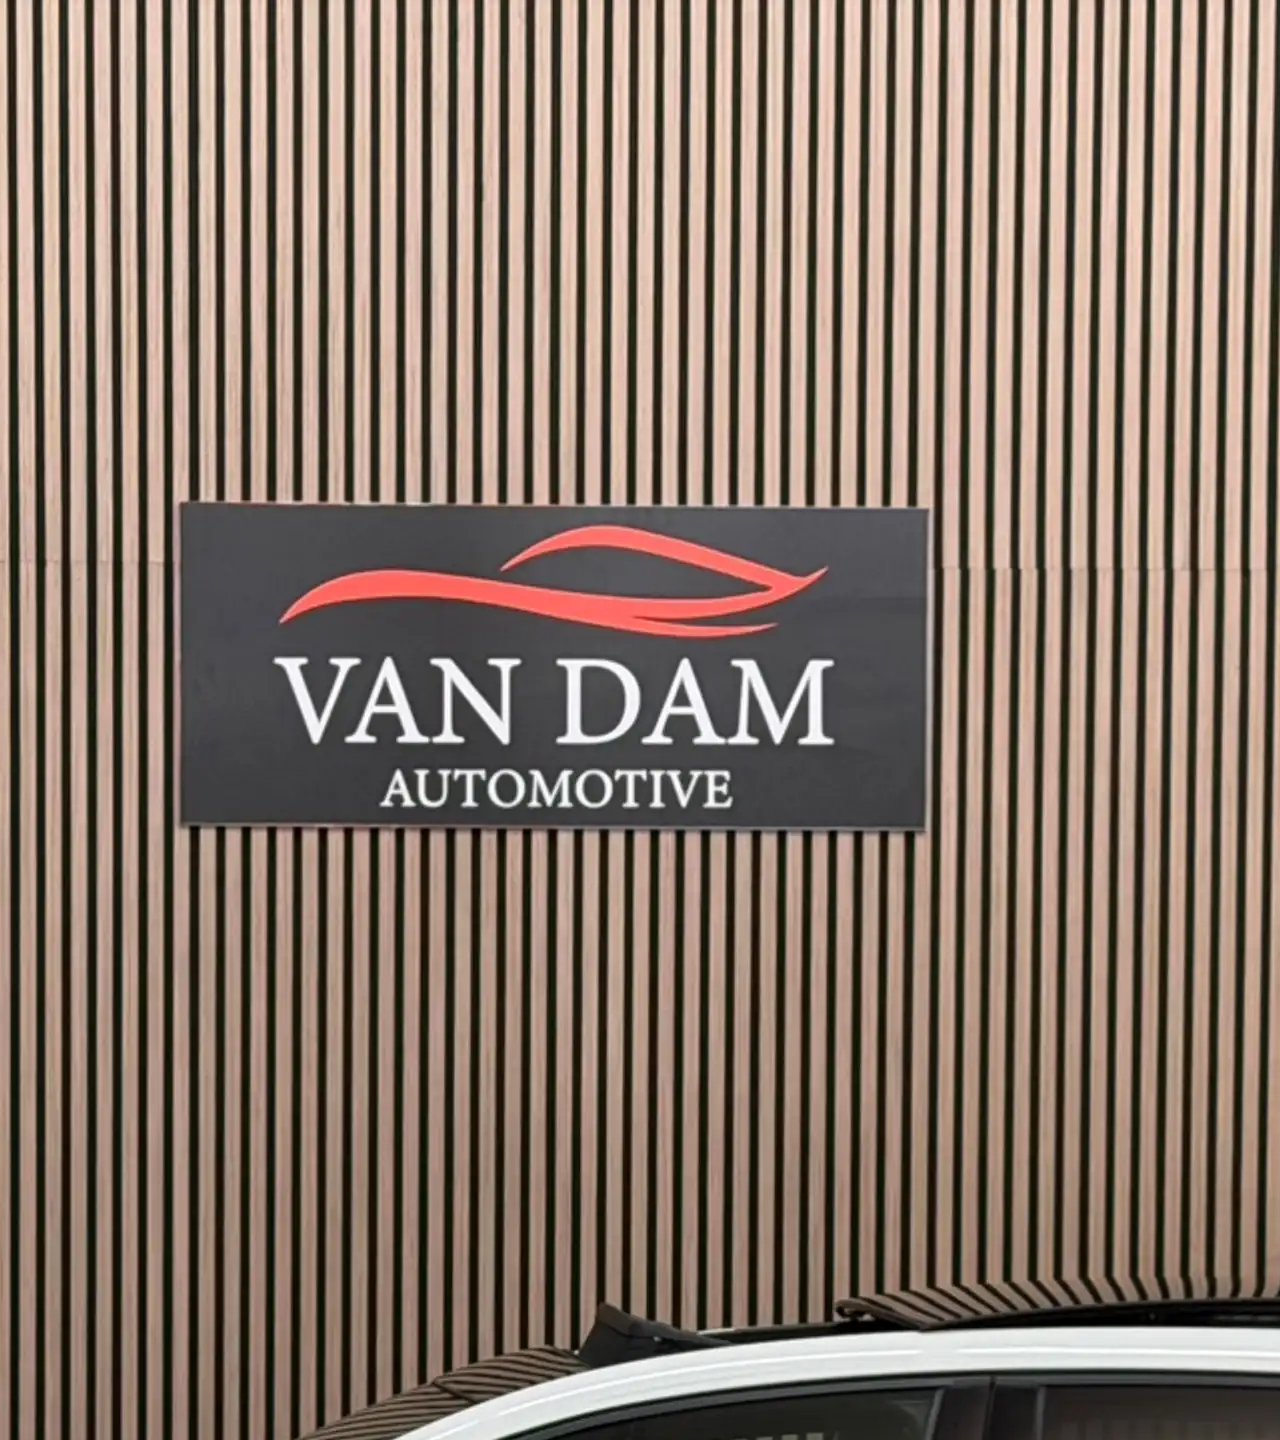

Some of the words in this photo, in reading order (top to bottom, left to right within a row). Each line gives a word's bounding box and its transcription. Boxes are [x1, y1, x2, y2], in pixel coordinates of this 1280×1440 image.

[274, 656, 522, 745] VAN
[556, 657, 835, 746] DAM
[379, 769, 734, 809] AUTOMOTIVE
